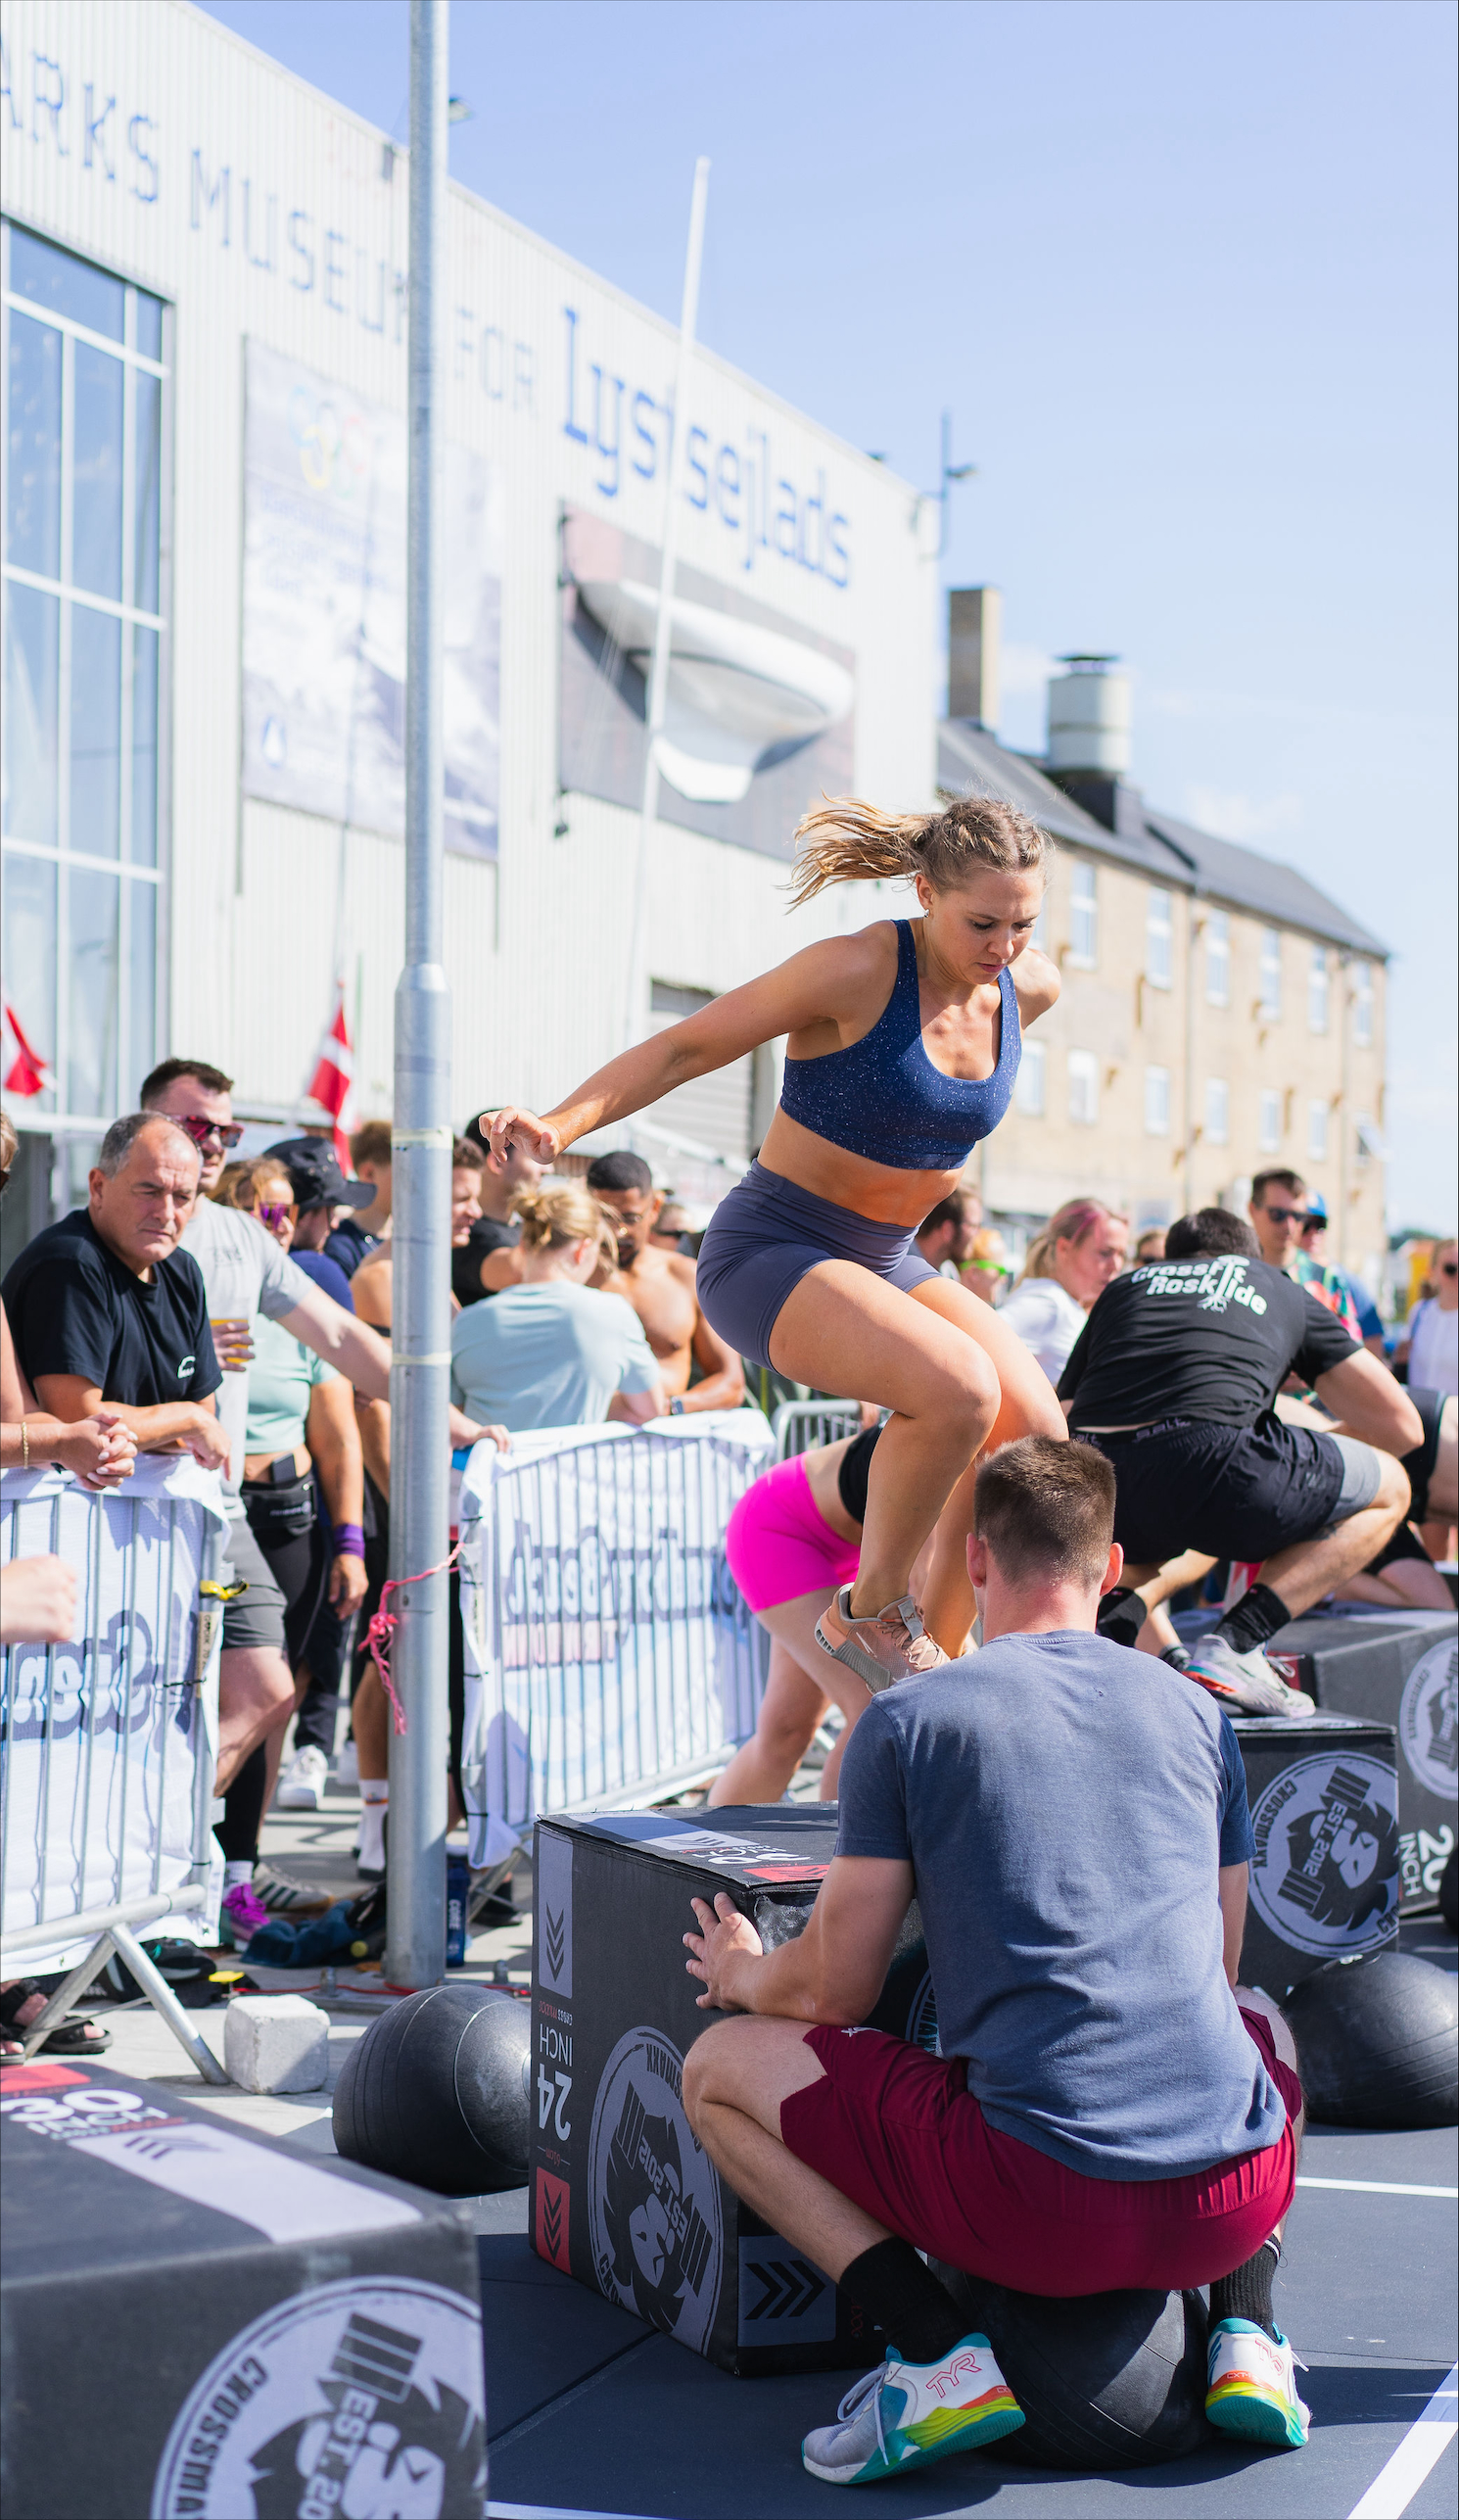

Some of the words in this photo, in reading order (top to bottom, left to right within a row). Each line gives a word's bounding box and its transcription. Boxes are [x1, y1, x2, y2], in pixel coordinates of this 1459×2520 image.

[1398, 1831, 1422, 1898] INCH
[540, 2023, 573, 2068] INCH
[0, 2088, 144, 2122] 30
[25, 2106, 169, 2136] INCH
[538, 2063, 573, 2142] 24
[925, 2353, 982, 2399] TYR
